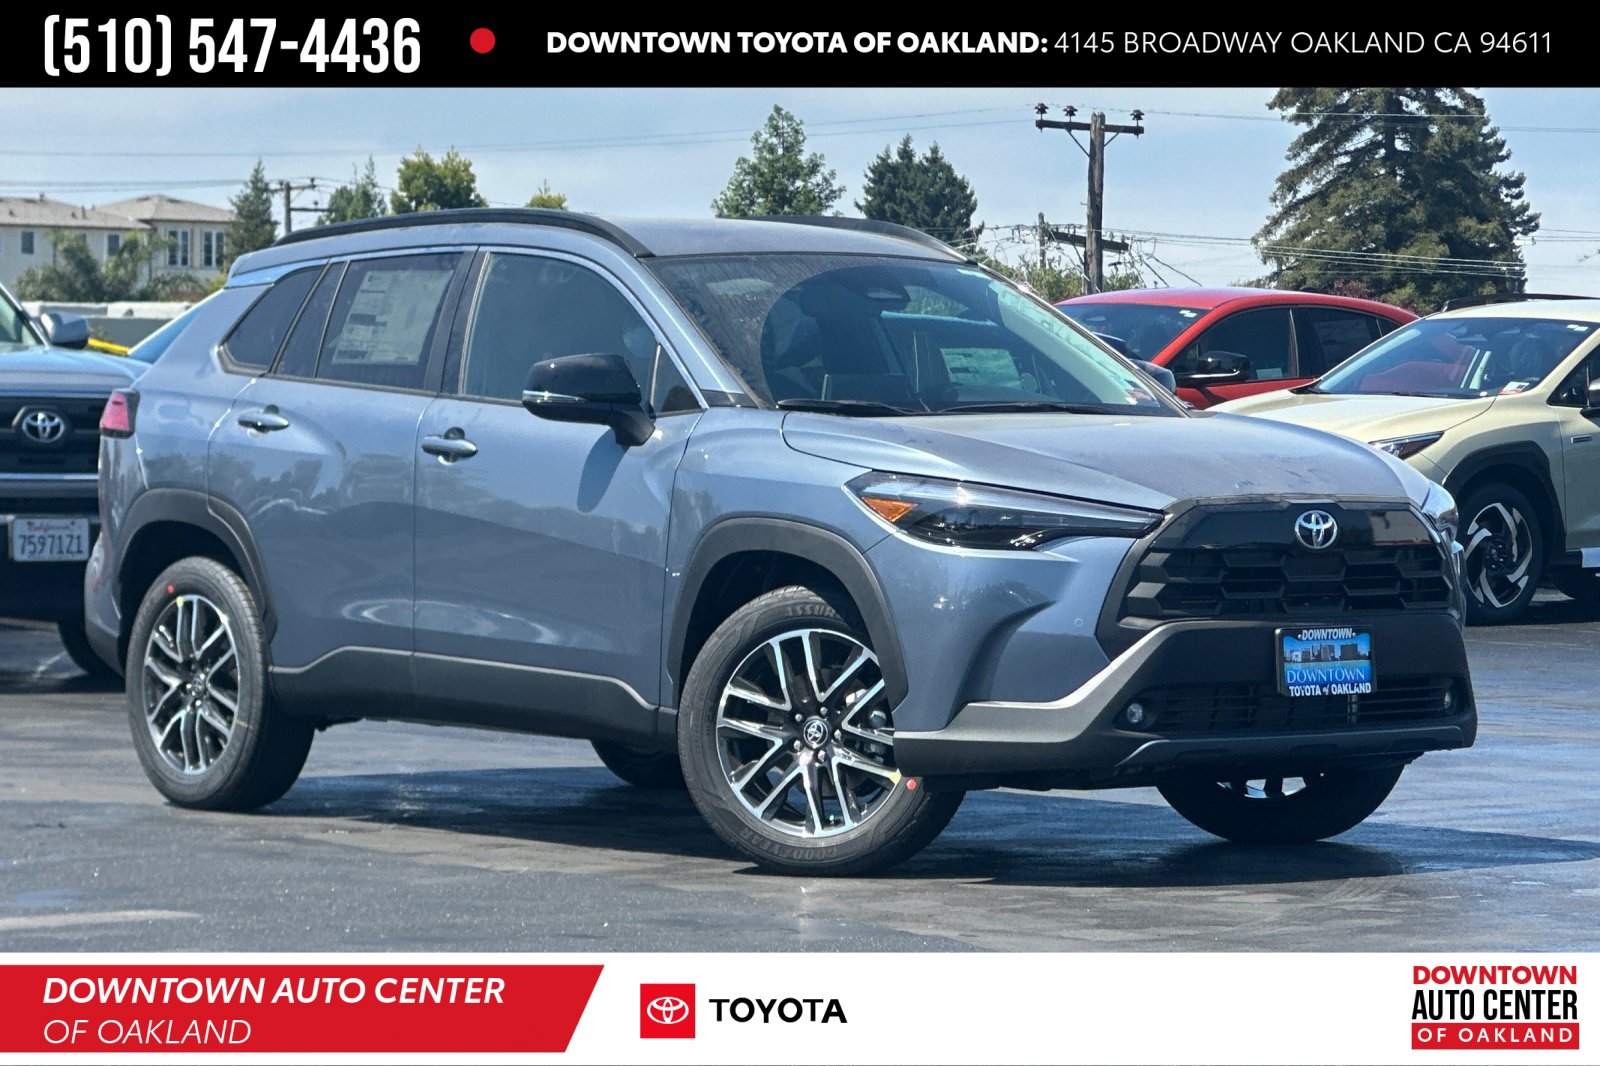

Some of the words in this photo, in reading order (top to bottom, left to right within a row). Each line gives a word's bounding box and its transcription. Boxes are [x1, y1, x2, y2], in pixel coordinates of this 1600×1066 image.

[18, 534, 84, 556] 75971Z1
[784, 604, 840, 618] ASSUR
[1301, 628, 1353, 641] DOWNTOWN
[1287, 668, 1365, 684] DOWNTOWN
[1289, 684, 1322, 697] TOYOTA
[1331, 682, 1372, 695] OAKLAND
